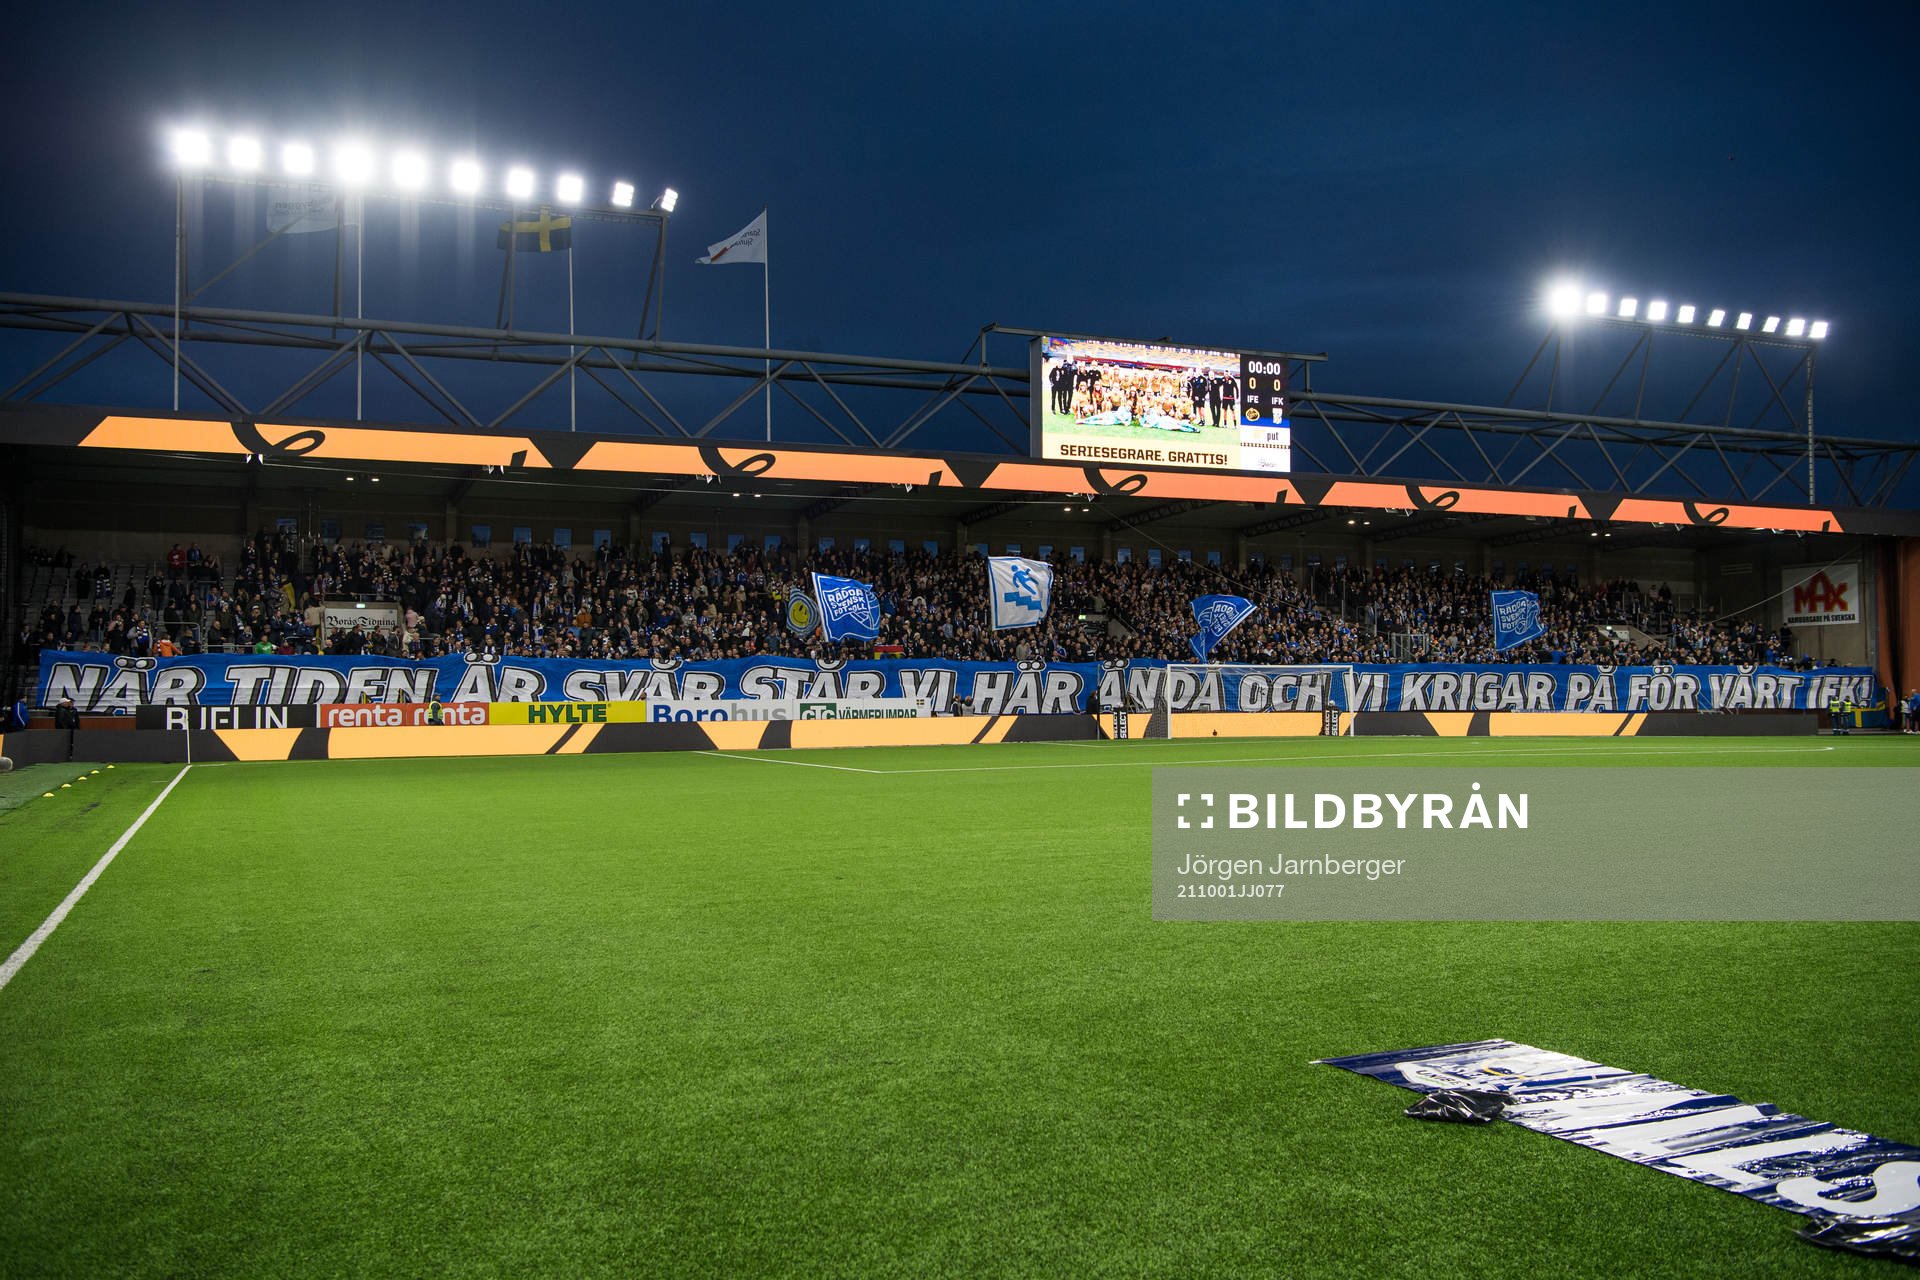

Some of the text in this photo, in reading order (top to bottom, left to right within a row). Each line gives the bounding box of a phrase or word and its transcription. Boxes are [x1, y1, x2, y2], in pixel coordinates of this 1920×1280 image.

[1248, 361, 1280, 375] 00:00
[1249, 377, 1280, 391] 0 0
[1247, 395, 1283, 405] IFE IFK
[1060, 444, 1228, 465] SERIESEGRARE. GRATTIS!
[1793, 570, 1848, 614] MAX
[43, 656, 205, 714] NÄR
[225, 664, 438, 704] TIDEN
[451, 652, 546, 702] ÄR
[564, 657, 726, 700] SVÅR
[739, 658, 886, 699] STÅR
[900, 669, 957, 714] VI
[972, 660, 1084, 714] HÄR
[1238, 671, 1331, 712] OCH
[1344, 671, 1389, 712] VI
[1401, 671, 1557, 712] KRIGAR
[1564, 665, 1618, 711] PÅ
[1627, 665, 1701, 710] FÖR
[1709, 665, 1805, 709] VÅRT
[1807, 675, 1874, 708] IFK!
[328, 704, 402, 727] renta
[529, 704, 607, 723] HYLTE
[653, 703, 787, 722] Borohus
[801, 705, 837, 720] CTC
